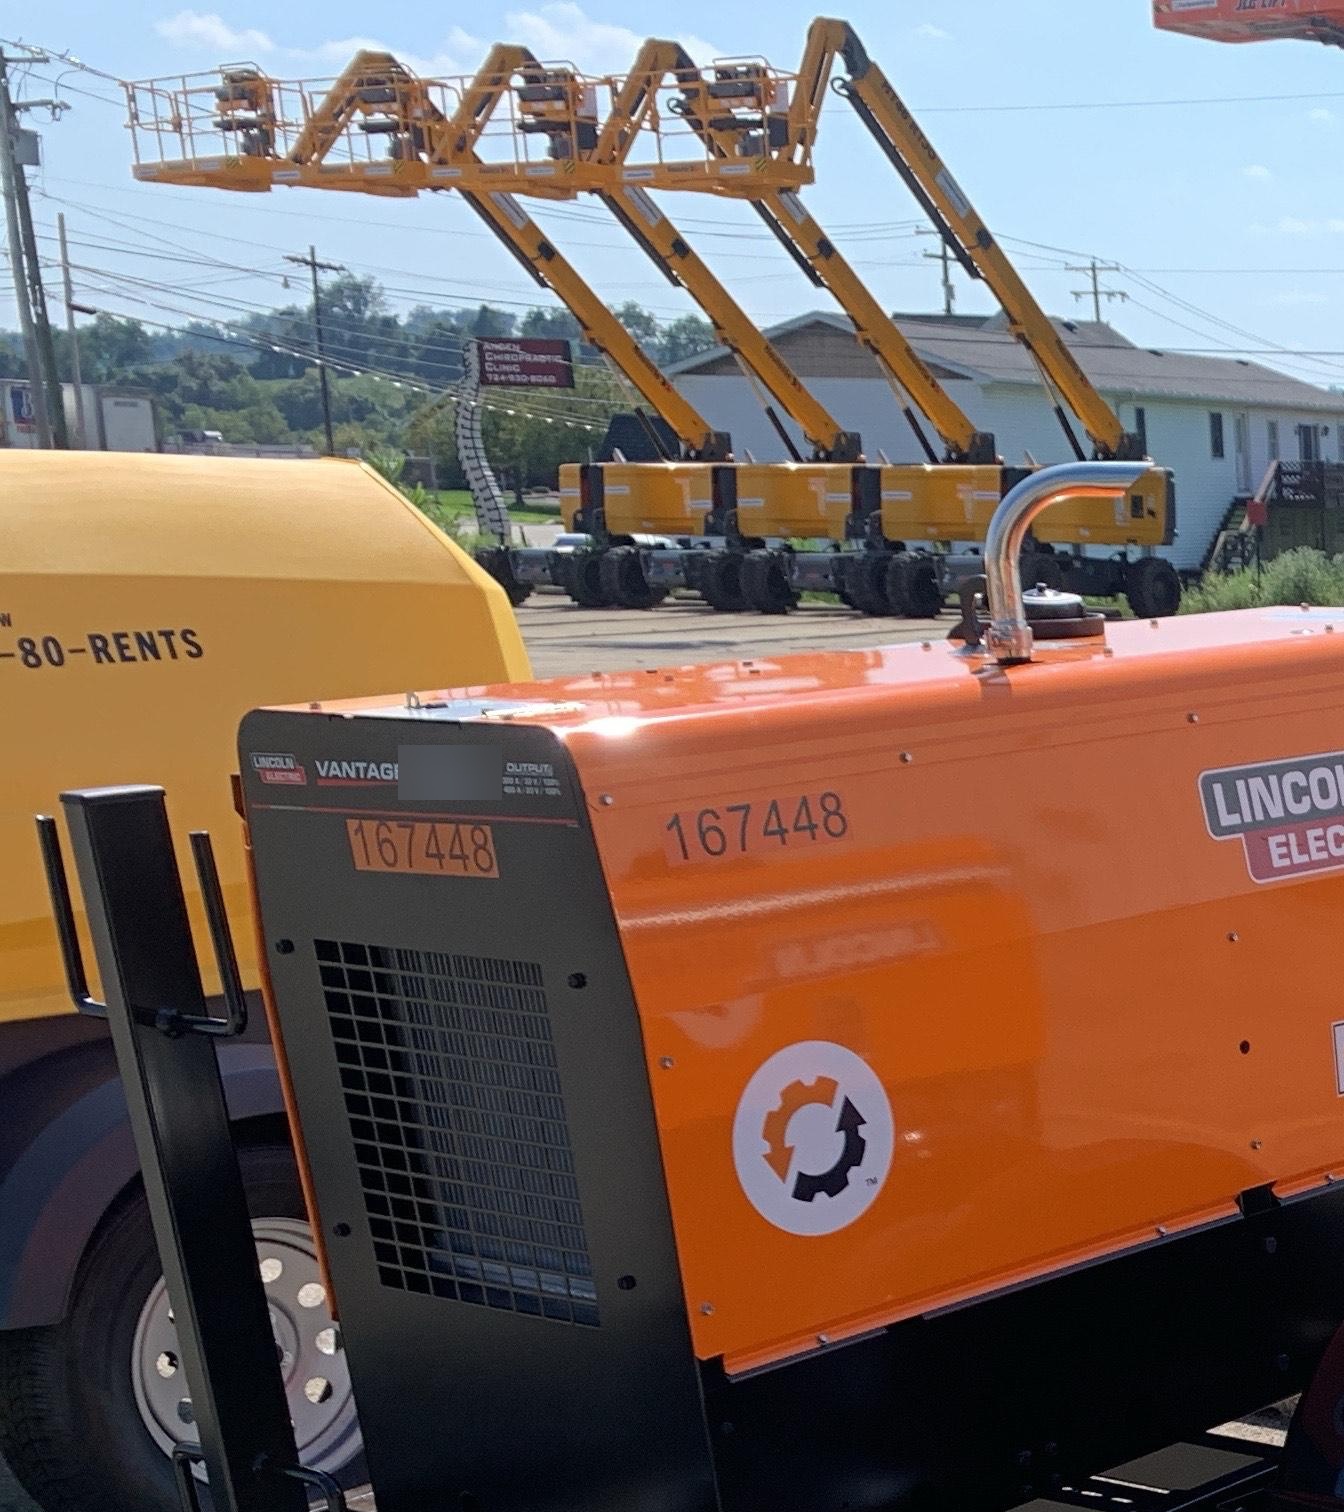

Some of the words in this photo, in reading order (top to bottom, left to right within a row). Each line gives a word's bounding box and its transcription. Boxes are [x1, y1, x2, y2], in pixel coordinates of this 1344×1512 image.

[253, 755, 295, 770] LINCOLN
[353, 821, 496, 873] 167448
[666, 791, 849, 861] 167448
